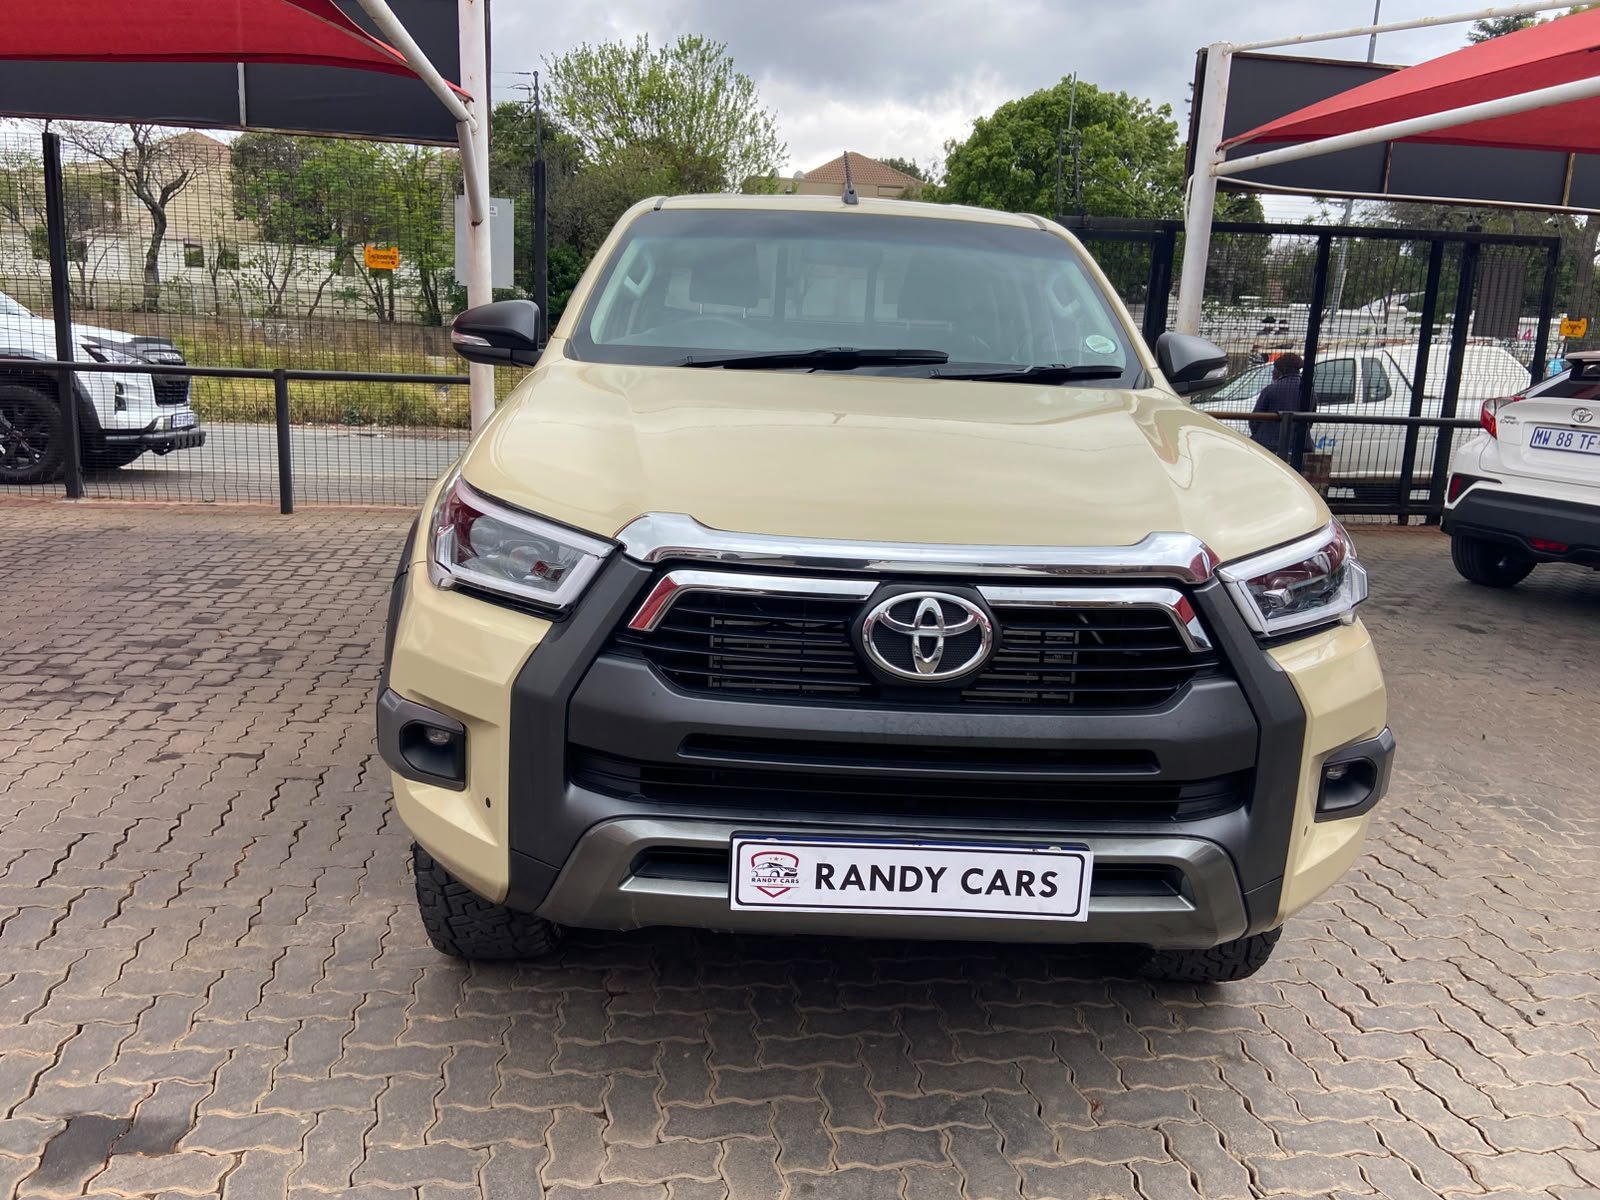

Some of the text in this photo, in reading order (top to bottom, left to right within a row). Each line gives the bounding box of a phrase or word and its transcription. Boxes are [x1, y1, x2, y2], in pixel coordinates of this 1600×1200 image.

[1534, 429, 1598, 450] MW 88 TF
[814, 862, 1058, 898] RANDY CARS
